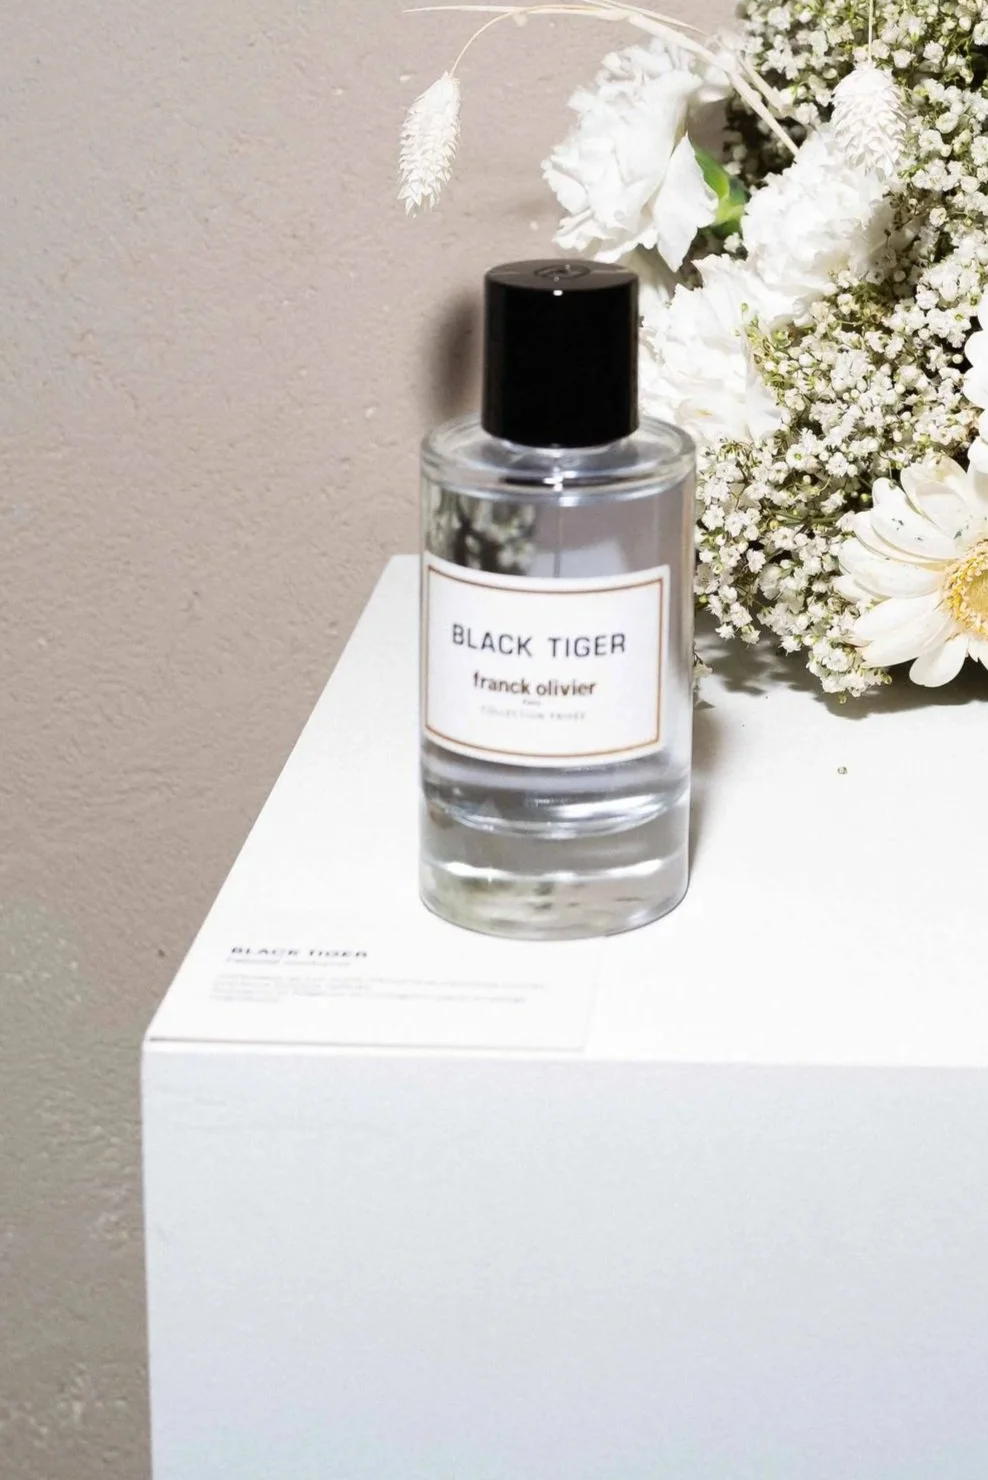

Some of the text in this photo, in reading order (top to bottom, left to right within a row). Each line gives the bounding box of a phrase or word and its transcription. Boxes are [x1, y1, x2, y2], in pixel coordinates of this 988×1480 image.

[452, 623, 626, 659] BLACK TIGER
[474, 671, 596, 696] franck olivier
[231, 946, 368, 958] BLACK TIGER
